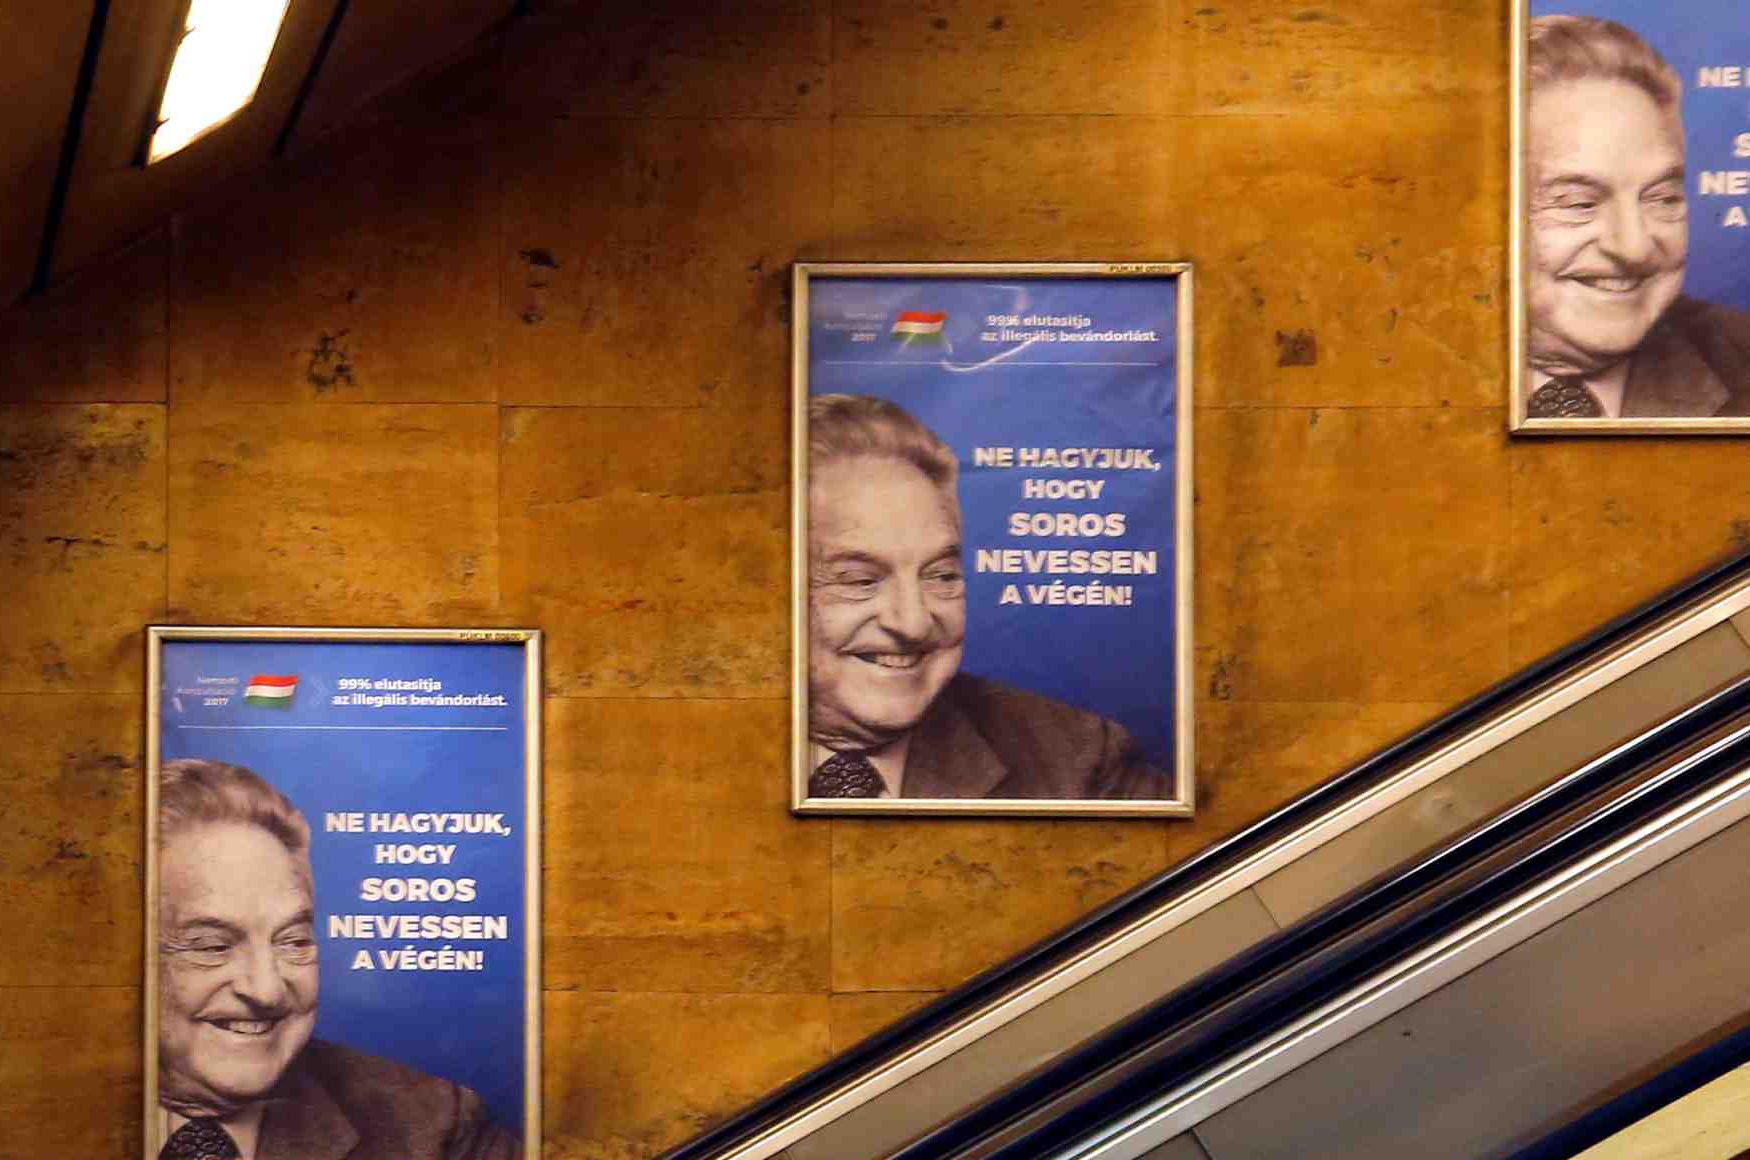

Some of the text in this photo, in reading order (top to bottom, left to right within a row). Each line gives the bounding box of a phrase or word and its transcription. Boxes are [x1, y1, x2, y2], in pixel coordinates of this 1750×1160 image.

[1700, 67, 1741, 87] NE
[1723, 206, 1748, 227] A
[974, 448, 1161, 472] NE HAGYJUK,
[1024, 479, 1104, 499] HOGY
[1010, 513, 1125, 537] SOROS
[977, 550, 1156, 574] NEVESSEN
[1000, 580, 1133, 606] A VÉGÉN!
[339, 679, 371, 689] 99%
[333, 695, 350, 704] az
[326, 813, 511, 836] NE HAGYJUK,
[376, 845, 455, 864] HOGY
[362, 878, 476, 901] SOROS
[330, 915, 506, 938] NEVESSEN
[353, 944, 483, 970] A VÉGÉN!
